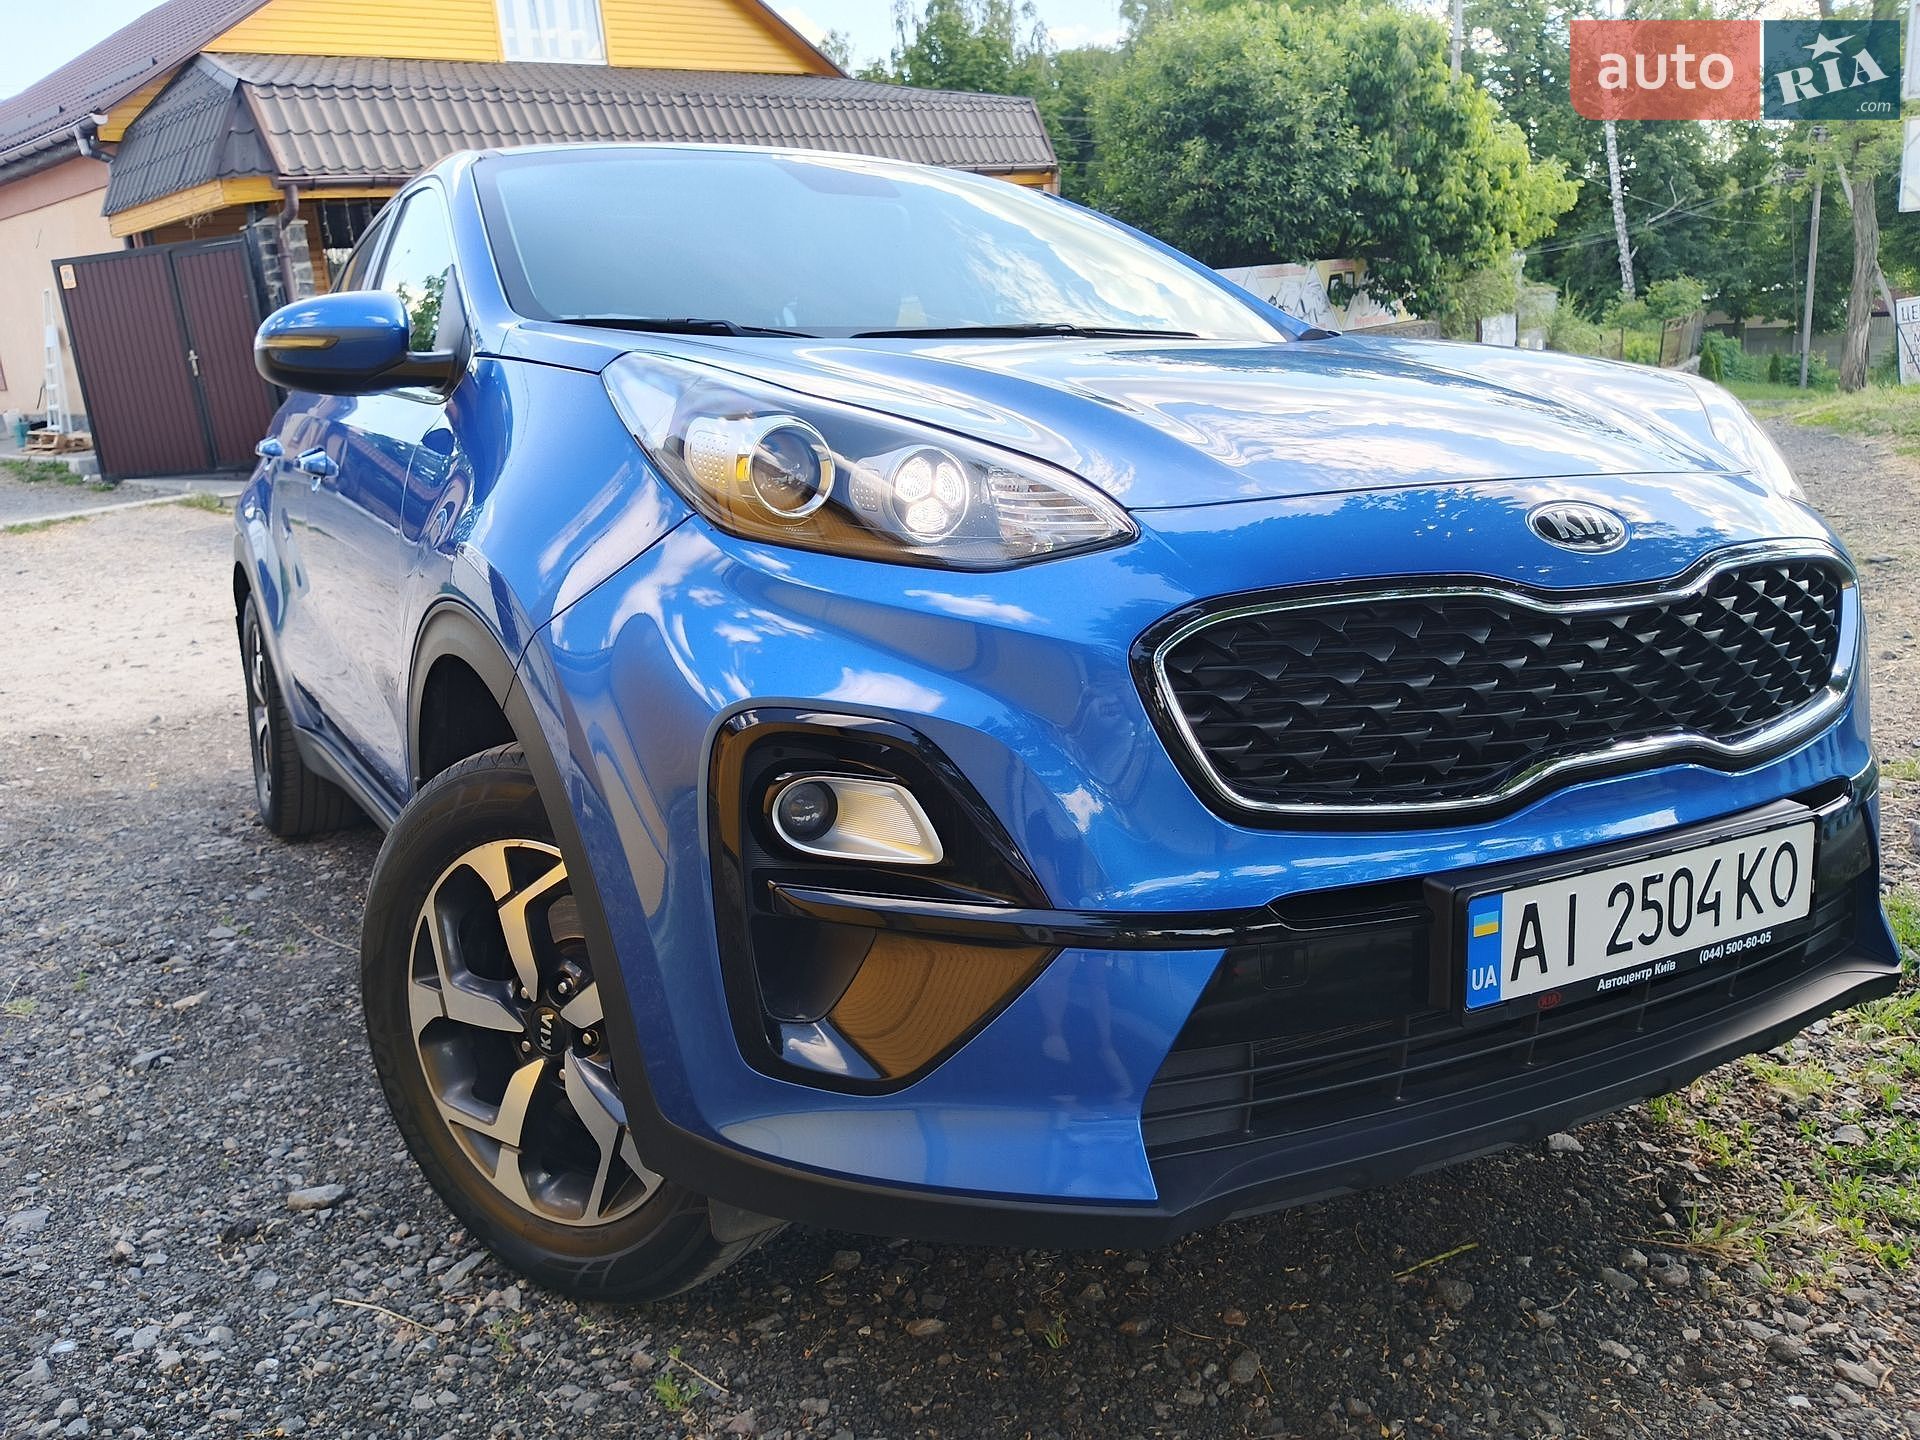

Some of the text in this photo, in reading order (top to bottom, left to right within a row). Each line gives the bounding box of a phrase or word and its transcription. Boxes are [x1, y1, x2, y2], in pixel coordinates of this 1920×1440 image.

[1545, 510, 1618, 539] KIA
[1510, 841, 1799, 982] AI 2504 KO
[1471, 967, 1498, 991] UA
[1597, 931, 1772, 992] Автоцентр Київ (044) 500-60-05
[541, 1014, 554, 1051] KIA
